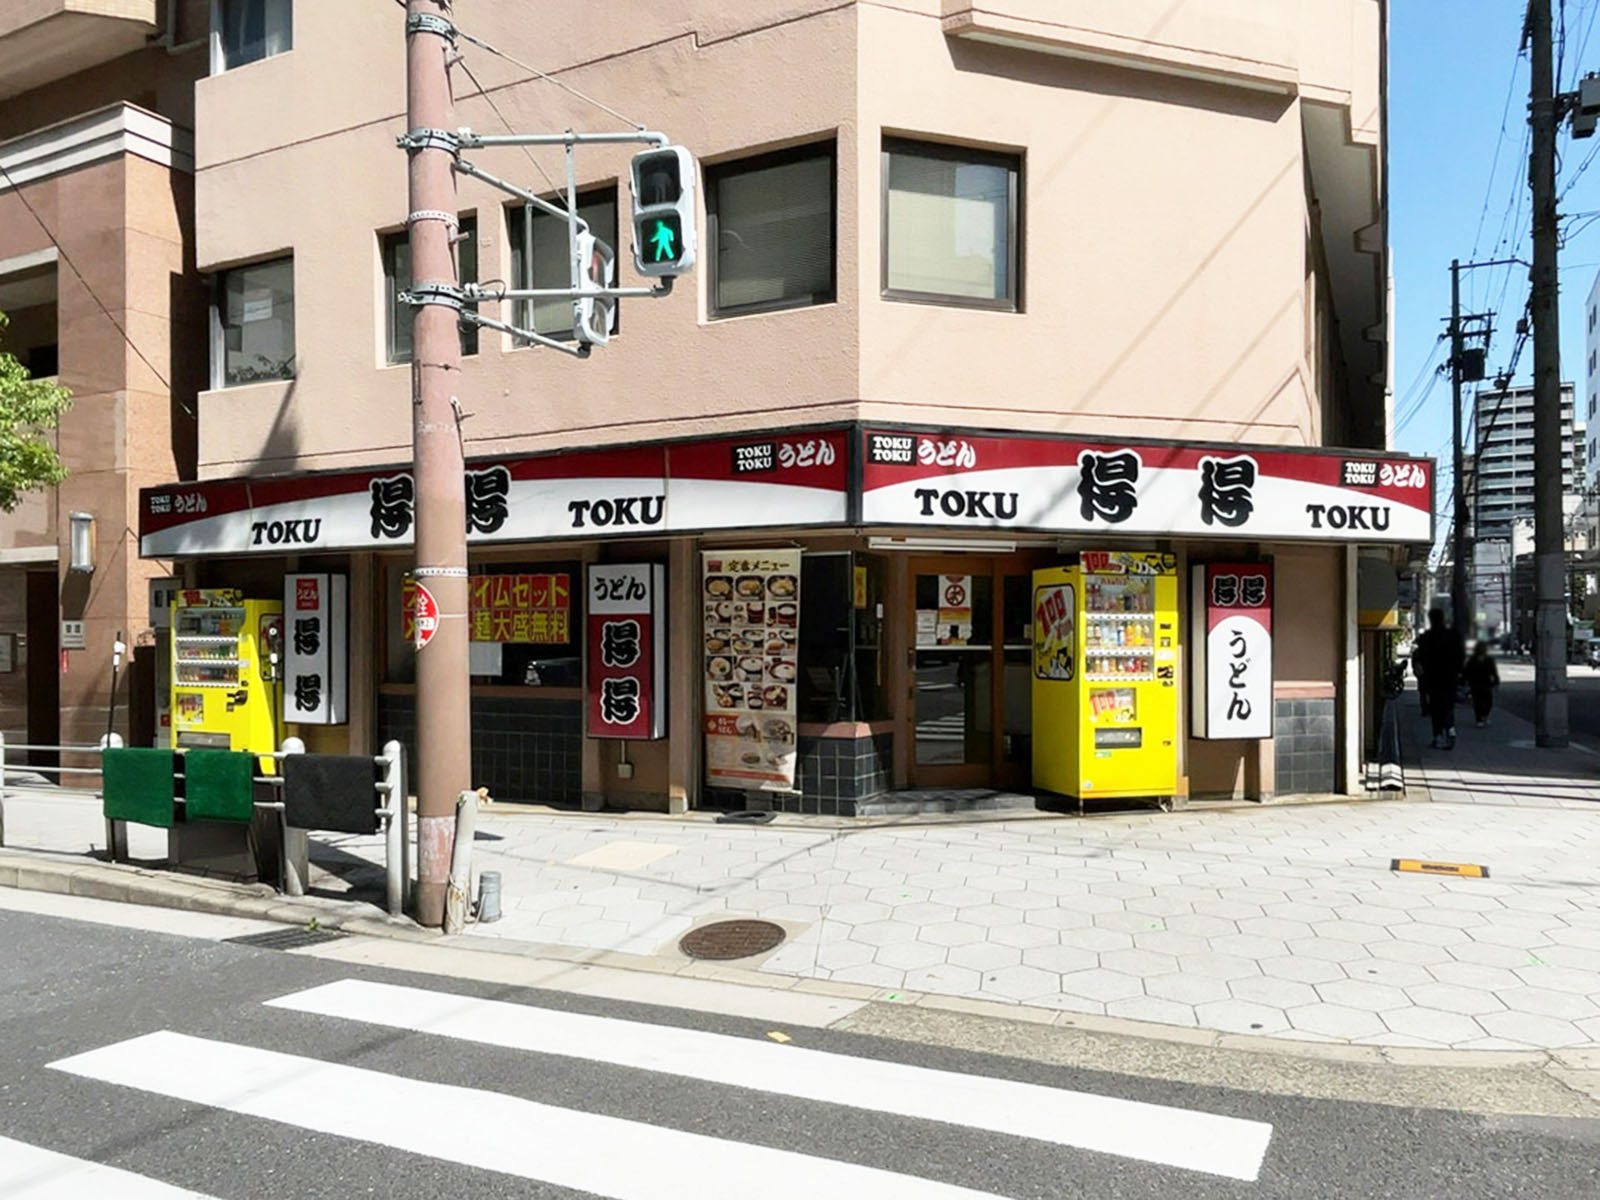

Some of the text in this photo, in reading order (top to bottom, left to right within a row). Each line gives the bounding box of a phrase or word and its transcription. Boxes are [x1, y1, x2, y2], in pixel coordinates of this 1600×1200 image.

[736, 445, 771, 458] TOKU
[873, 436, 912, 449] TOKU
[737, 457, 772, 471] TOKU
[779, 440, 835, 468] うどん
[873, 449, 912, 462] TOKU
[918, 439, 976, 468] うどん
[1345, 462, 1376, 474] TOKU
[1379, 463, 1425, 489] うどん
[1345, 473, 1376, 485] TOKU
[151, 505, 171, 514] TOKU
[174, 492, 208, 513] うどん
[914, 488, 1019, 520] TOKU
[1306, 504, 1390, 532] TOKU
[252, 518, 322, 545] TOKU
[568, 495, 666, 528] TOKU
[594, 575, 646, 601] うどん
[1226, 629, 1252, 721] うどん
